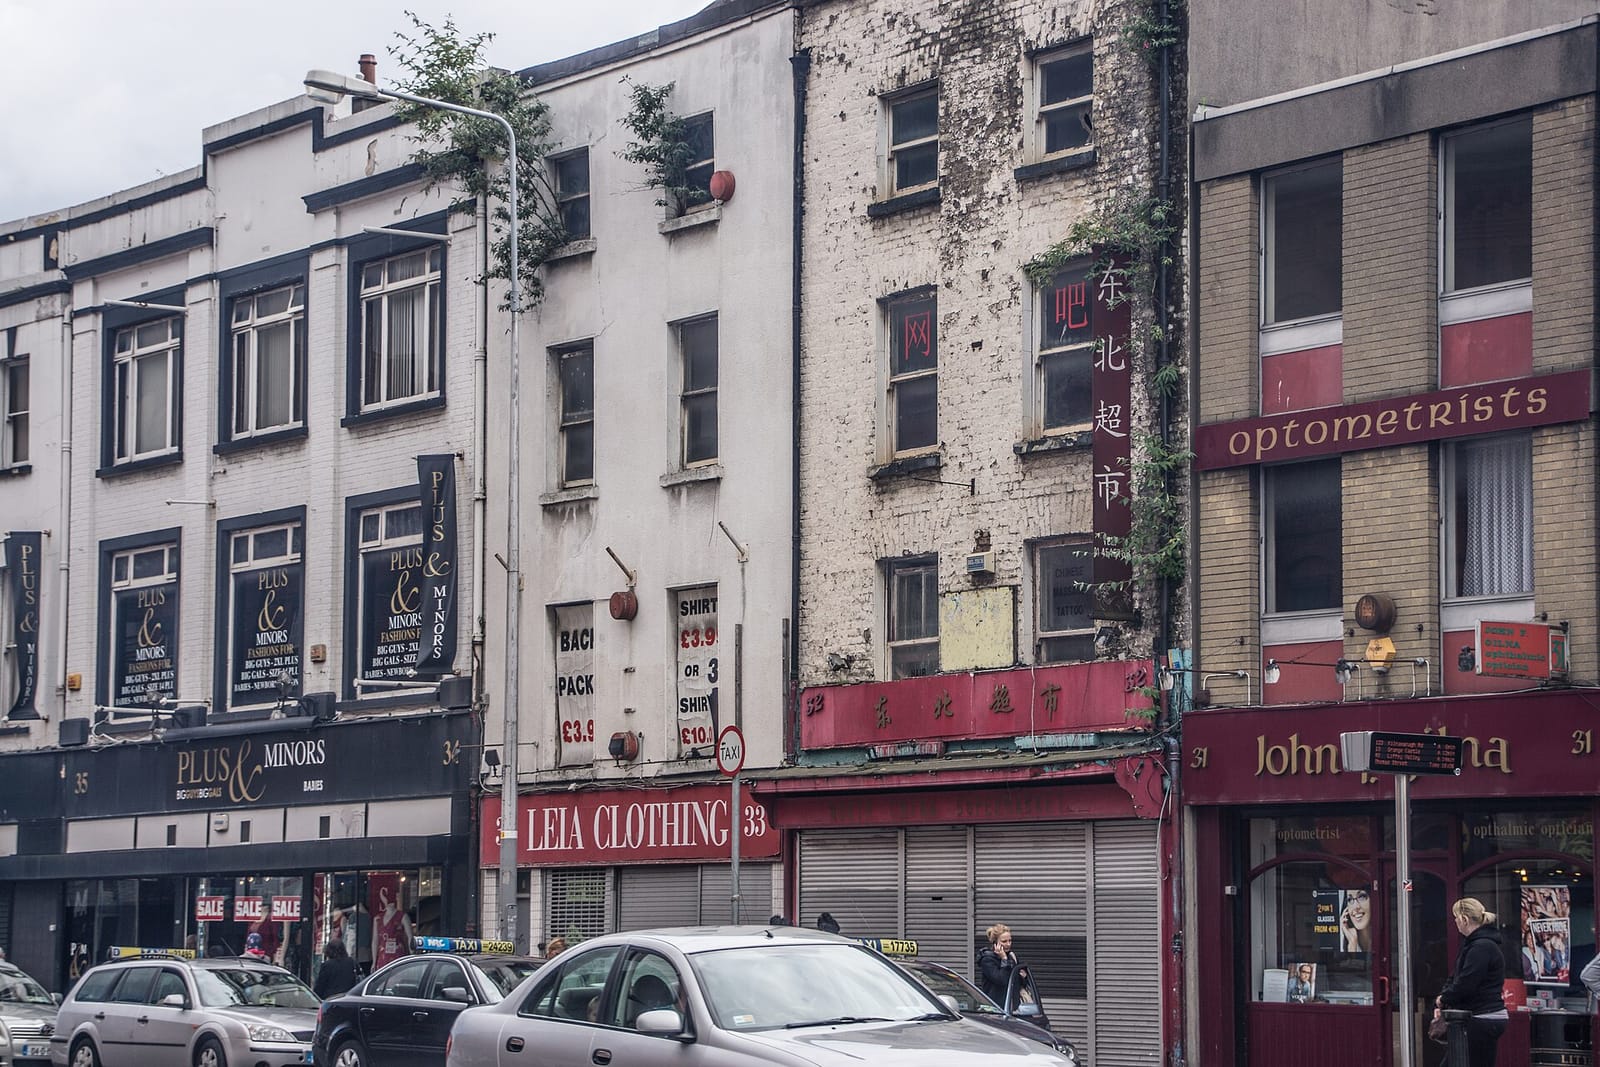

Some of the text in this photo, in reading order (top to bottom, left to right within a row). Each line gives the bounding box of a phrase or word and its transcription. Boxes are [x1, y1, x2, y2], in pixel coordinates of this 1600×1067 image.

[905, 281, 1088, 360] 网 吧
[1094, 258, 1127, 511] 东北超市
[1228, 387, 1548, 460] optometrists
[390, 547, 423, 571] PLUS
[423, 471, 451, 659] PLUS & MINORS
[21, 545, 35, 605] PLUS
[258, 567, 288, 590] PLUS
[138, 587, 165, 608] PLUS
[391, 570, 421, 614] &
[258, 590, 287, 631] &
[388, 612, 422, 630] MINORS
[1056, 605, 1084, 617] TATTOO
[20, 611, 37, 633] &
[138, 608, 164, 648] &
[256, 630, 288, 646] MINORS
[681, 627, 718, 649] £3.9
[136, 645, 165, 661] MINORS
[248, 646, 279, 659] FASHIONS
[377, 645, 388, 655] BIG
[389, 643, 405, 654] GUYS
[1551, 639, 1565, 669] 31
[245, 660, 255, 669] BIG
[256, 658, 270, 668] GUYS
[373, 653, 417, 667] BIG GALS SIZE
[685, 664, 699, 677] OR
[241, 671, 251, 680] BIG
[252, 669, 266, 679] GALS
[559, 675, 594, 696] PACK
[680, 695, 709, 714] SHIR
[1571, 728, 1592, 754] 31
[720, 744, 740, 761] TAXI
[1190, 746, 1208, 769] 31
[1255, 733, 1342, 776] John
[177, 738, 325, 803] PLUS & MINORS
[74, 772, 88, 794] 35
[303, 780, 324, 792] BABIES
[526, 805, 585, 852] LEIA
[593, 799, 728, 850] CLOTHING
[743, 805, 766, 837] 33
[1278, 825, 1341, 842] optometrist
[1473, 820, 1536, 839] opthalmic
[197, 900, 224, 917] SALE
[235, 900, 262, 917] SALE
[272, 900, 300, 917] SALE
[455, 940, 478, 950] TAXI
[488, 941, 513, 952] 24239
[891, 941, 915, 952] 17735
